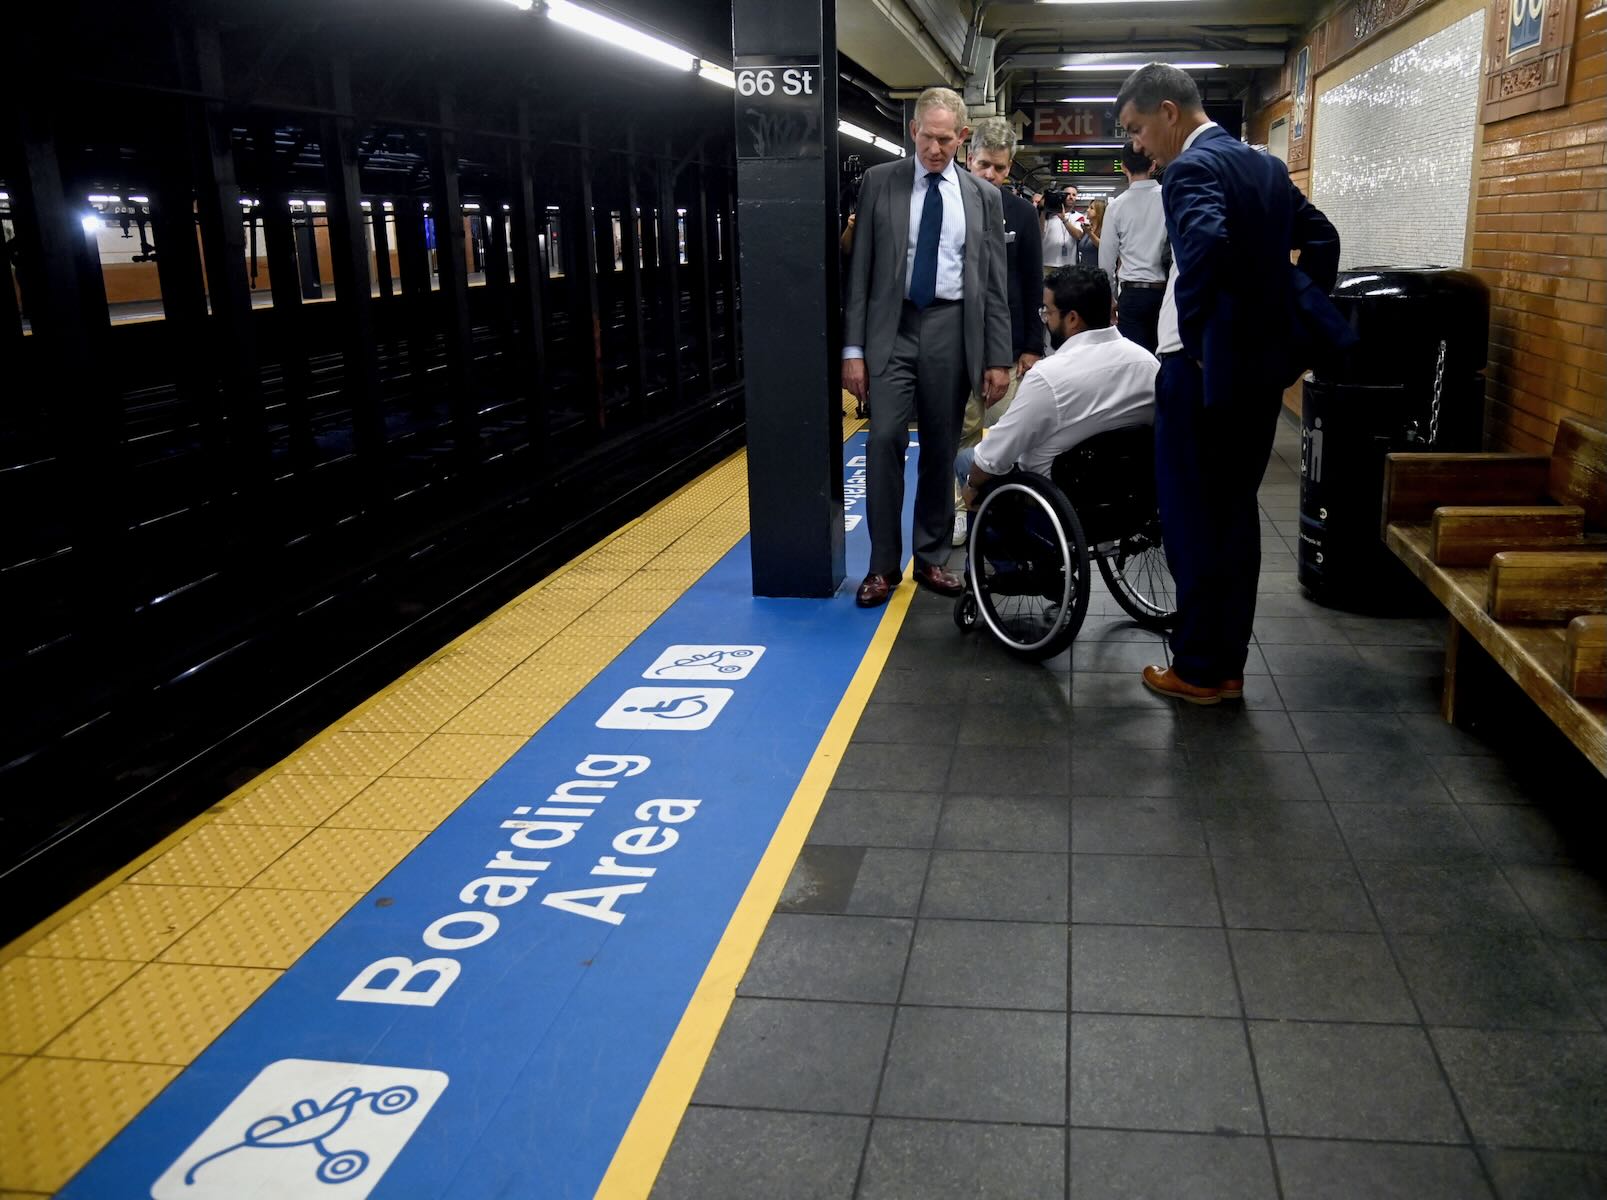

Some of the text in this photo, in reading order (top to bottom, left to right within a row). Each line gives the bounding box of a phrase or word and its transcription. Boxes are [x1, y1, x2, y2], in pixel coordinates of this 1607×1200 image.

[738, 69, 812, 96] 66 St
[1034, 108, 1094, 136] Exit
[336, 753, 651, 1007] Boarding
[541, 798, 702, 925] Area
